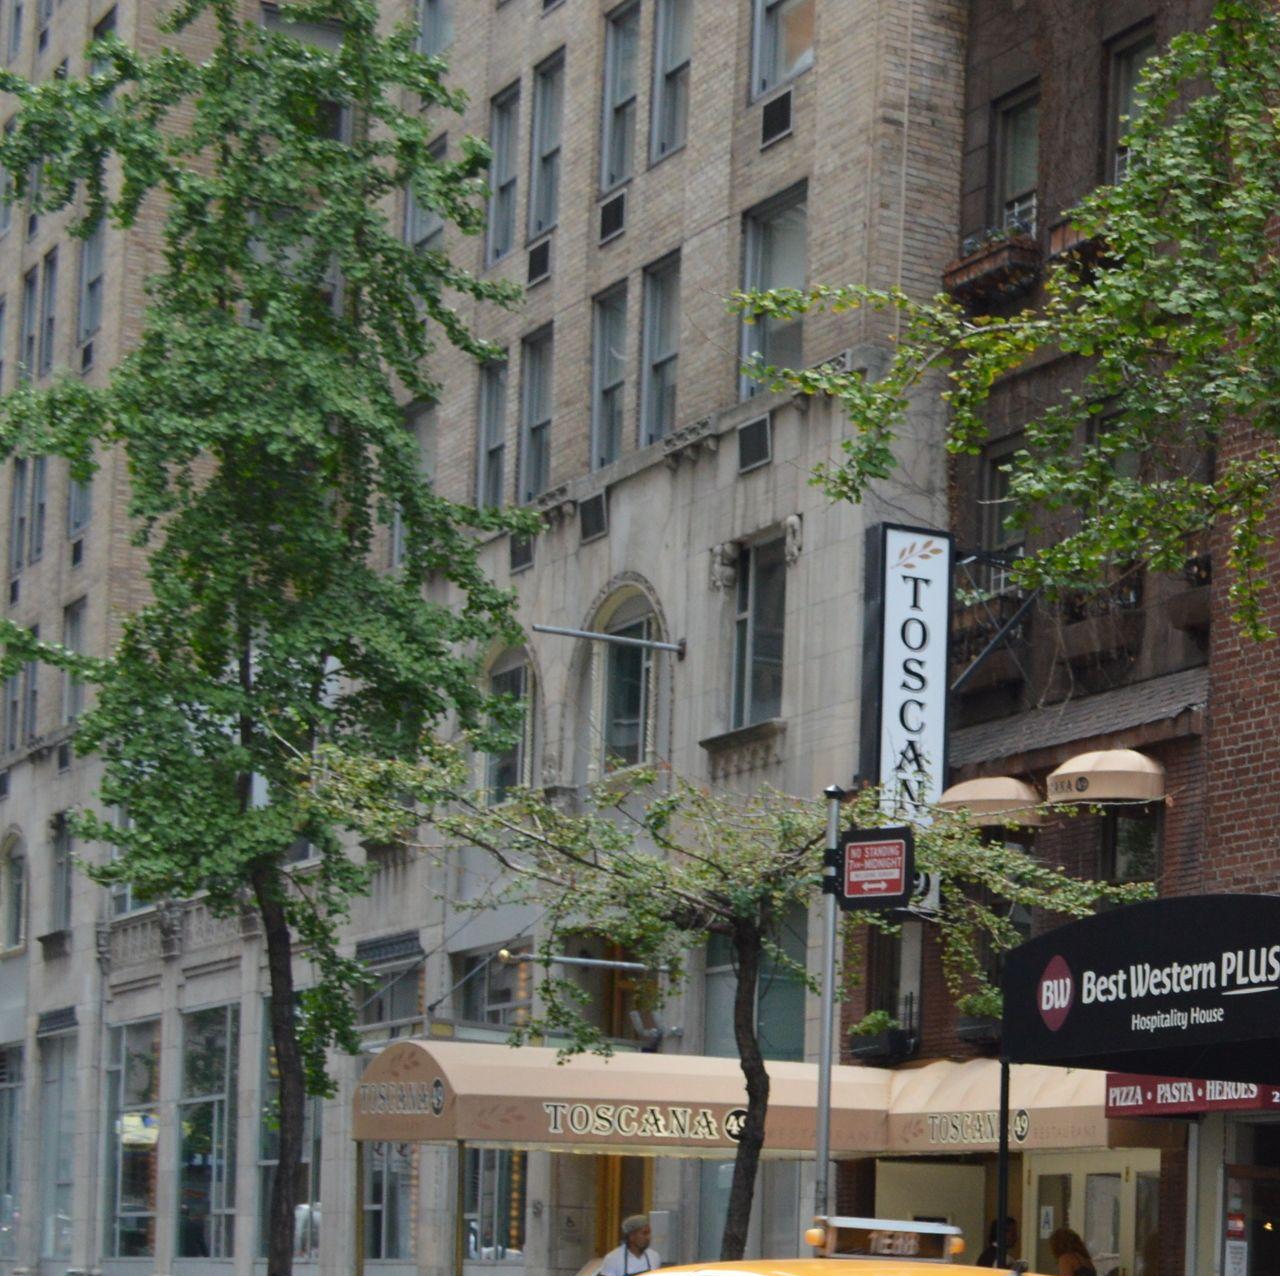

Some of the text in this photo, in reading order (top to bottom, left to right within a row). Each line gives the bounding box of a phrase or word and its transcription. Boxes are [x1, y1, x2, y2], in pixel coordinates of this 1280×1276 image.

[894, 575, 931, 813] TOSCAN
[1082, 945, 1280, 1004] Best Western PLUS
[1041, 978, 1071, 1010] BW
[1131, 1006, 1224, 1032] Hospitality House
[359, 1082, 430, 1114] TOSCANA
[1109, 1086, 1143, 1107] PIZZA
[1157, 1082, 1194, 1104] PASTA
[544, 1103, 719, 1139] TOSCANA
[928, 1112, 1010, 1144] TOSCAN
[1014, 1114, 1028, 1137] 49
